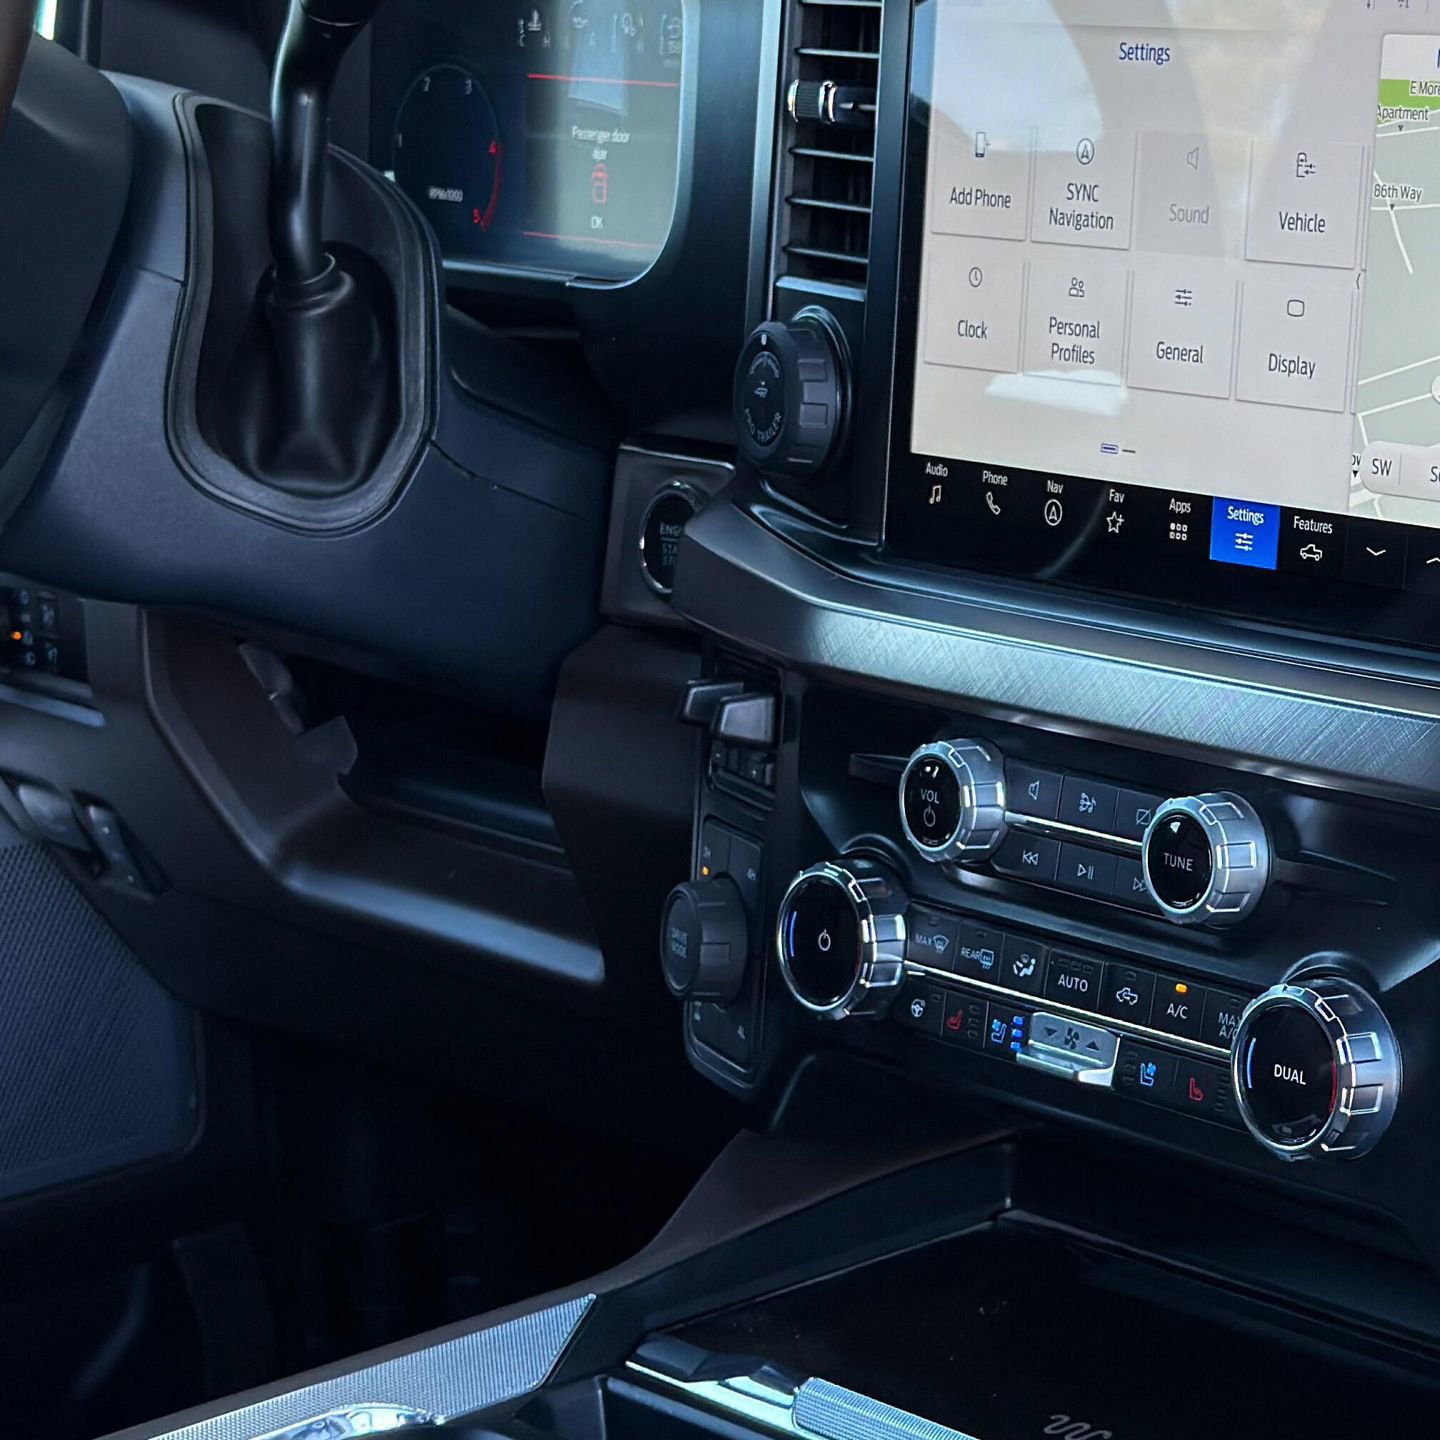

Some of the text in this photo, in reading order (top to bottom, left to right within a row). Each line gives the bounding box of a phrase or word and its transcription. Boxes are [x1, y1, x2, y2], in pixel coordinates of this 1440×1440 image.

[1118, 42, 1171, 66] Settings
[949, 186, 1012, 209] Add Phone
[1066, 182, 1101, 203] SYNC
[1373, 184, 1423, 203] 86th Way
[1048, 207, 1115, 233] Navigation
[1168, 203, 1211, 226] Sound
[1278, 211, 1327, 234] Vehicle
[956, 319, 989, 341] Clock
[1048, 316, 1101, 340] Personal
[1050, 342, 1096, 366] Profiles
[1155, 340, 1204, 364] General
[1267, 353, 1317, 380] Display
[925, 461, 949, 478] Audio
[1371, 457, 1393, 477] SW
[981, 469, 1009, 487] Phone
[1046, 480, 1065, 495] Nav
[1108, 488, 1125, 504] Fav
[1169, 497, 1192, 516] Apps
[1227, 505, 1266, 526] Settings
[1292, 515, 1334, 535] Features
[920, 788, 940, 805] VOL
[1163, 851, 1194, 872] TUNE
[915, 933, 932, 945] MAX
[961, 946, 981, 961] REAR
[1057, 973, 1090, 993] AUTO
[1167, 1002, 1189, 1021] A/C
[1273, 1063, 1307, 1086] DUAL
